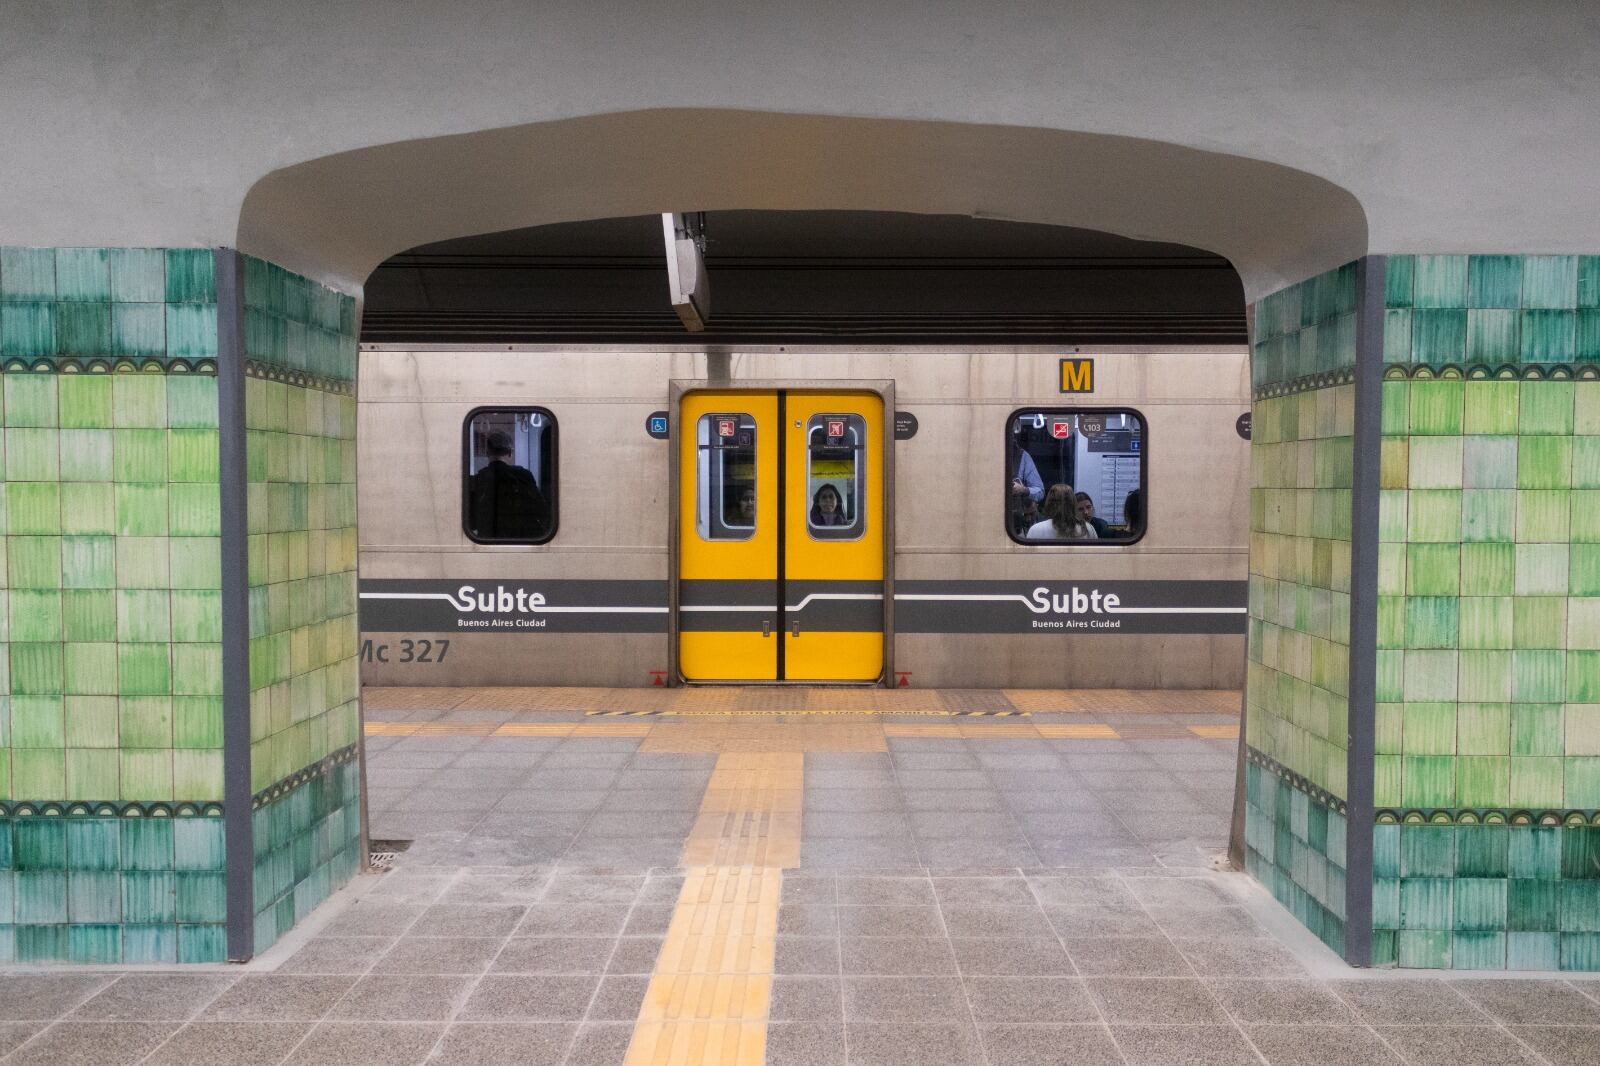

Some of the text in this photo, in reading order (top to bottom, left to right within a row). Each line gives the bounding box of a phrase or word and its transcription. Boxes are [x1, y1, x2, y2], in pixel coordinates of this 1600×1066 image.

[1063, 361, 1091, 391] M
[1087, 424, 1101, 432] 103
[457, 585, 547, 613] Subte
[1032, 586, 1121, 614] Subte
[457, 619, 546, 628] Buenos Aires Ciudad
[1032, 620, 1121, 628] Buenos Aires Ciudad
[400, 639, 450, 663] 327
